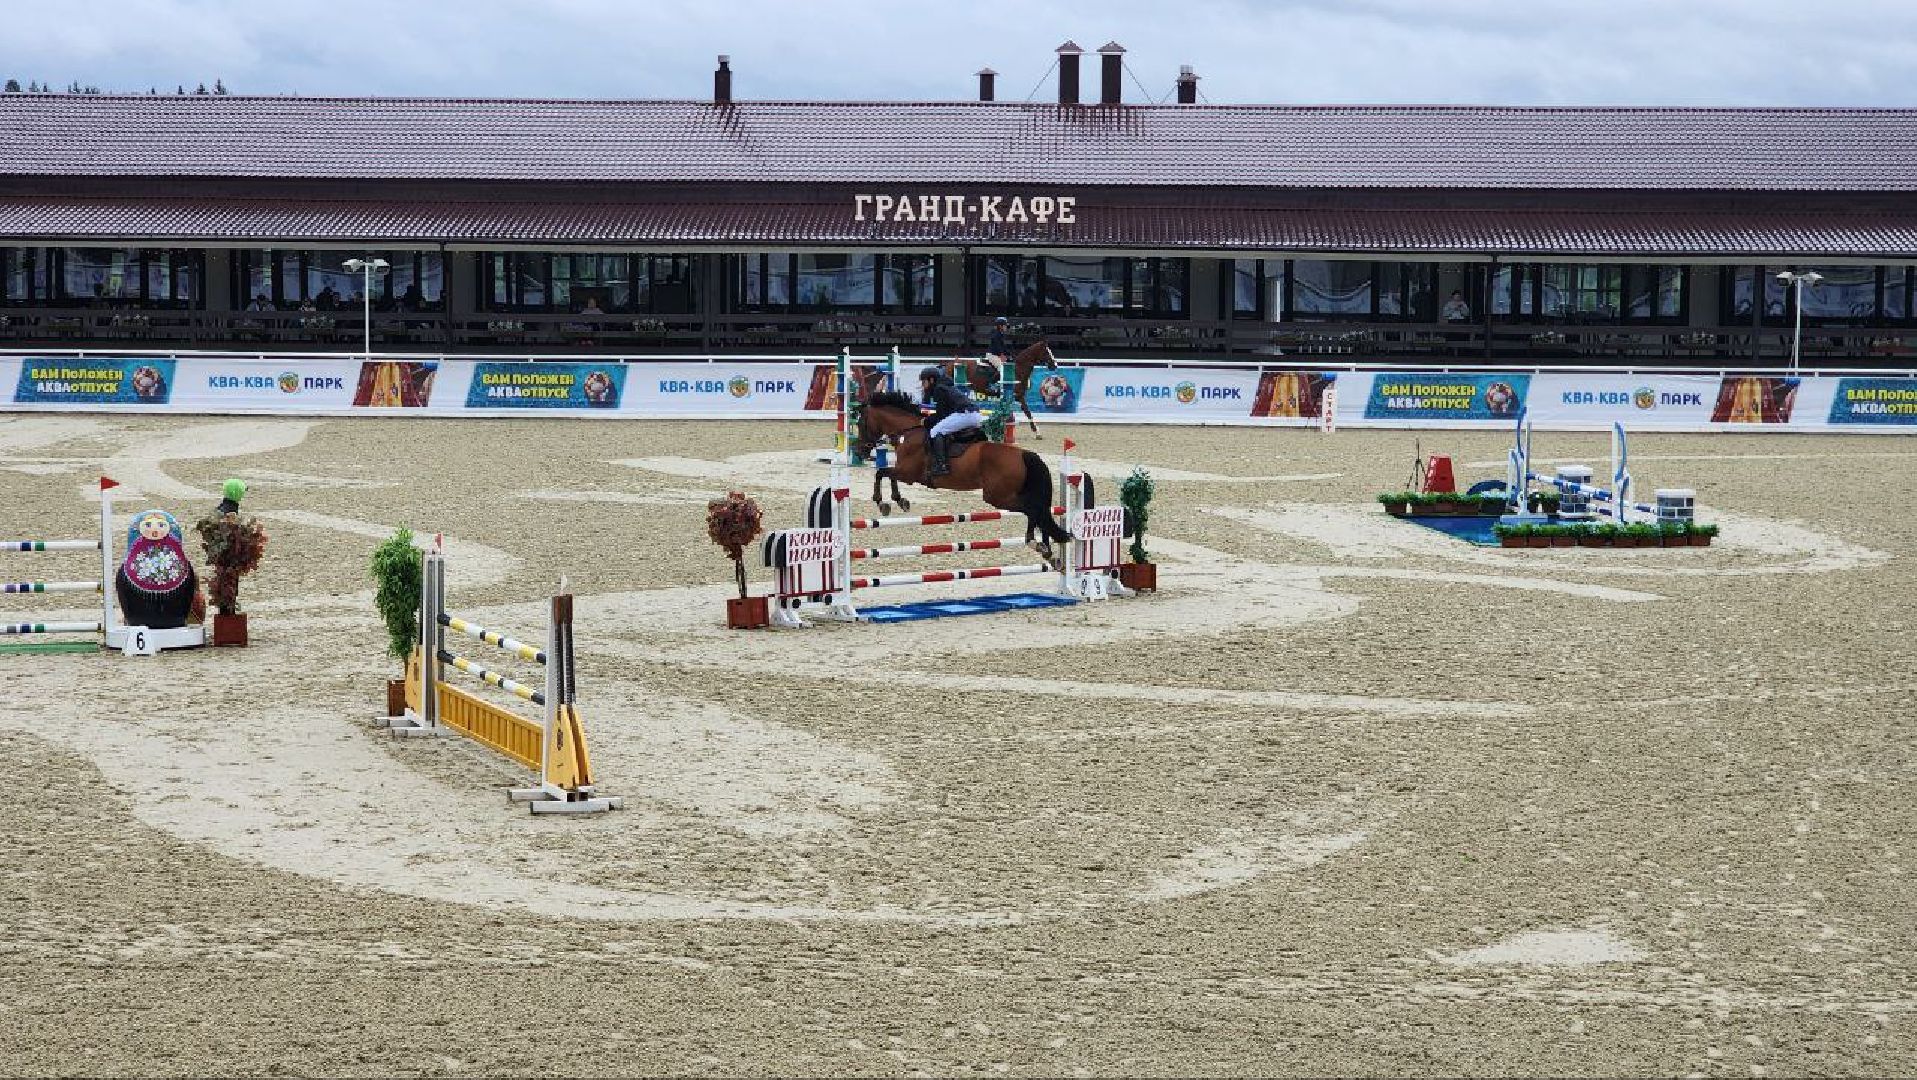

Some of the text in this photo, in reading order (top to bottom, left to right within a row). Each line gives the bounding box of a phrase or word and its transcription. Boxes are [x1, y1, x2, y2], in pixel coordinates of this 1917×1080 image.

[854, 194, 1076, 224] ГРАНД-КАФЕ
[31, 368, 59, 379] ВАМ
[482, 373, 510, 385] ВАМ
[304, 377, 343, 389] ПАРК
[755, 380, 796, 393] ПАРК
[1382, 383, 1410, 396] ВАМ
[1201, 386, 1241, 399] ПАРК
[1661, 392, 1702, 405] ПАРК
[788, 529, 833, 547] КОНИ
[788, 545, 833, 563] ПОНИ
[136, 632, 145, 650] 6
